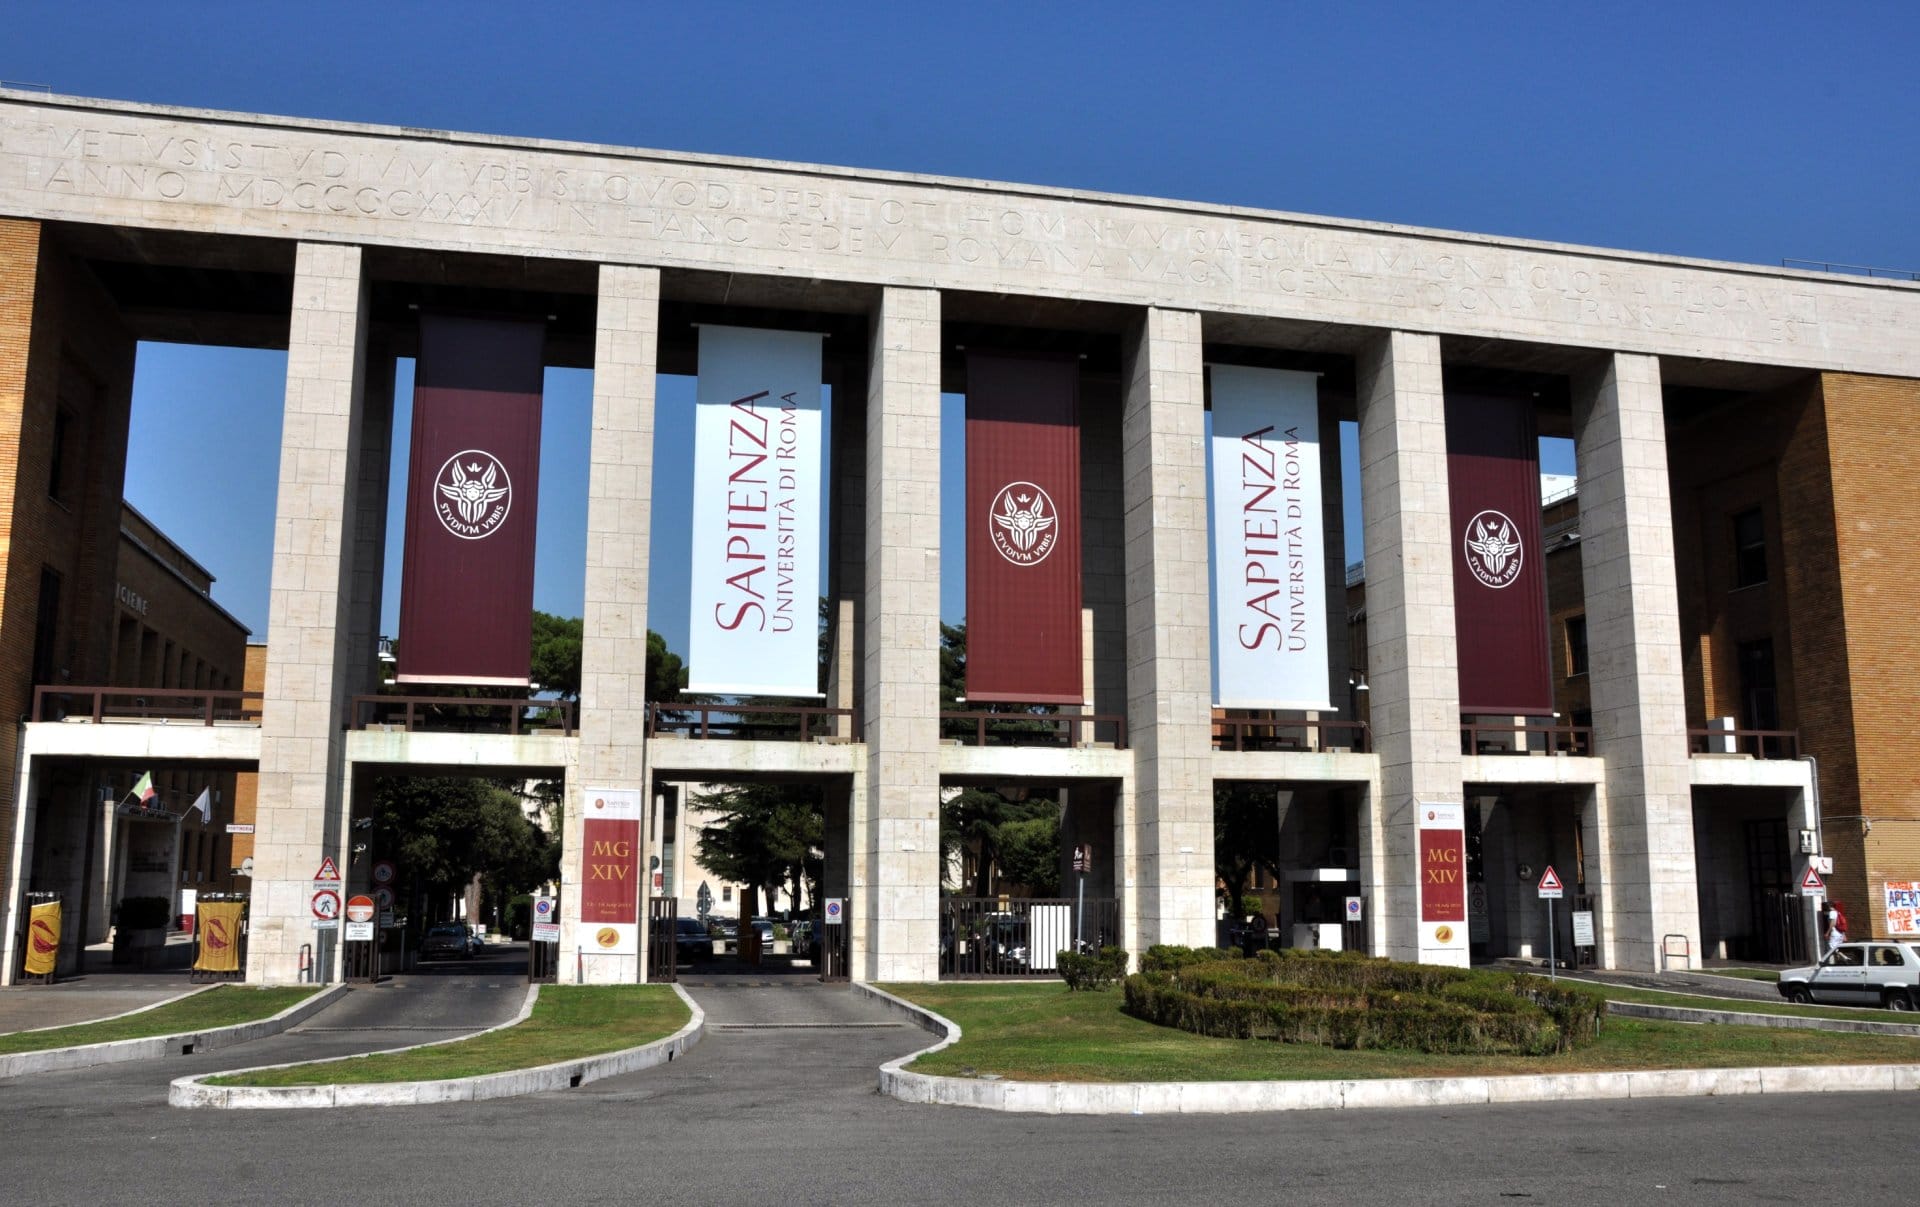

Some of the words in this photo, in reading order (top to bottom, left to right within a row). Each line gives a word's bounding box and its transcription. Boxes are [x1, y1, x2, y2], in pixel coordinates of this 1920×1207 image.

[49, 125, 199, 166] VETVS
[758, 185, 828, 221] PER
[848, 192, 938, 228] TOT
[45, 162, 186, 198] ANNO
[779, 220, 904, 256] SEDEM
[776, 391, 797, 460] ROMA
[1283, 426, 1300, 491] ROMA
[779, 468, 796, 490] DI
[440, 502, 480, 534] STVDIVM
[481, 504, 504, 530] VRBIS
[715, 390, 769, 632] SAPIENZA
[1287, 498, 1301, 518] DI
[995, 531, 1032, 561] STVDIVM
[1033, 533, 1052, 557] VRBIS
[1239, 425, 1282, 651] SAPIENZA
[773, 498, 795, 633] UNIVERSITÀ
[1470, 556, 1502, 584] STVDIVM
[1503, 558, 1519, 580] VRBIS
[1284, 526, 1306, 652] UNIVERSITÀ
[591, 840, 630, 858] MG
[1428, 848, 1457, 863] MG
[591, 864, 630, 881] XIV
[1428, 869, 1458, 884] XIV
[1892, 919, 1912, 932] LIVE
